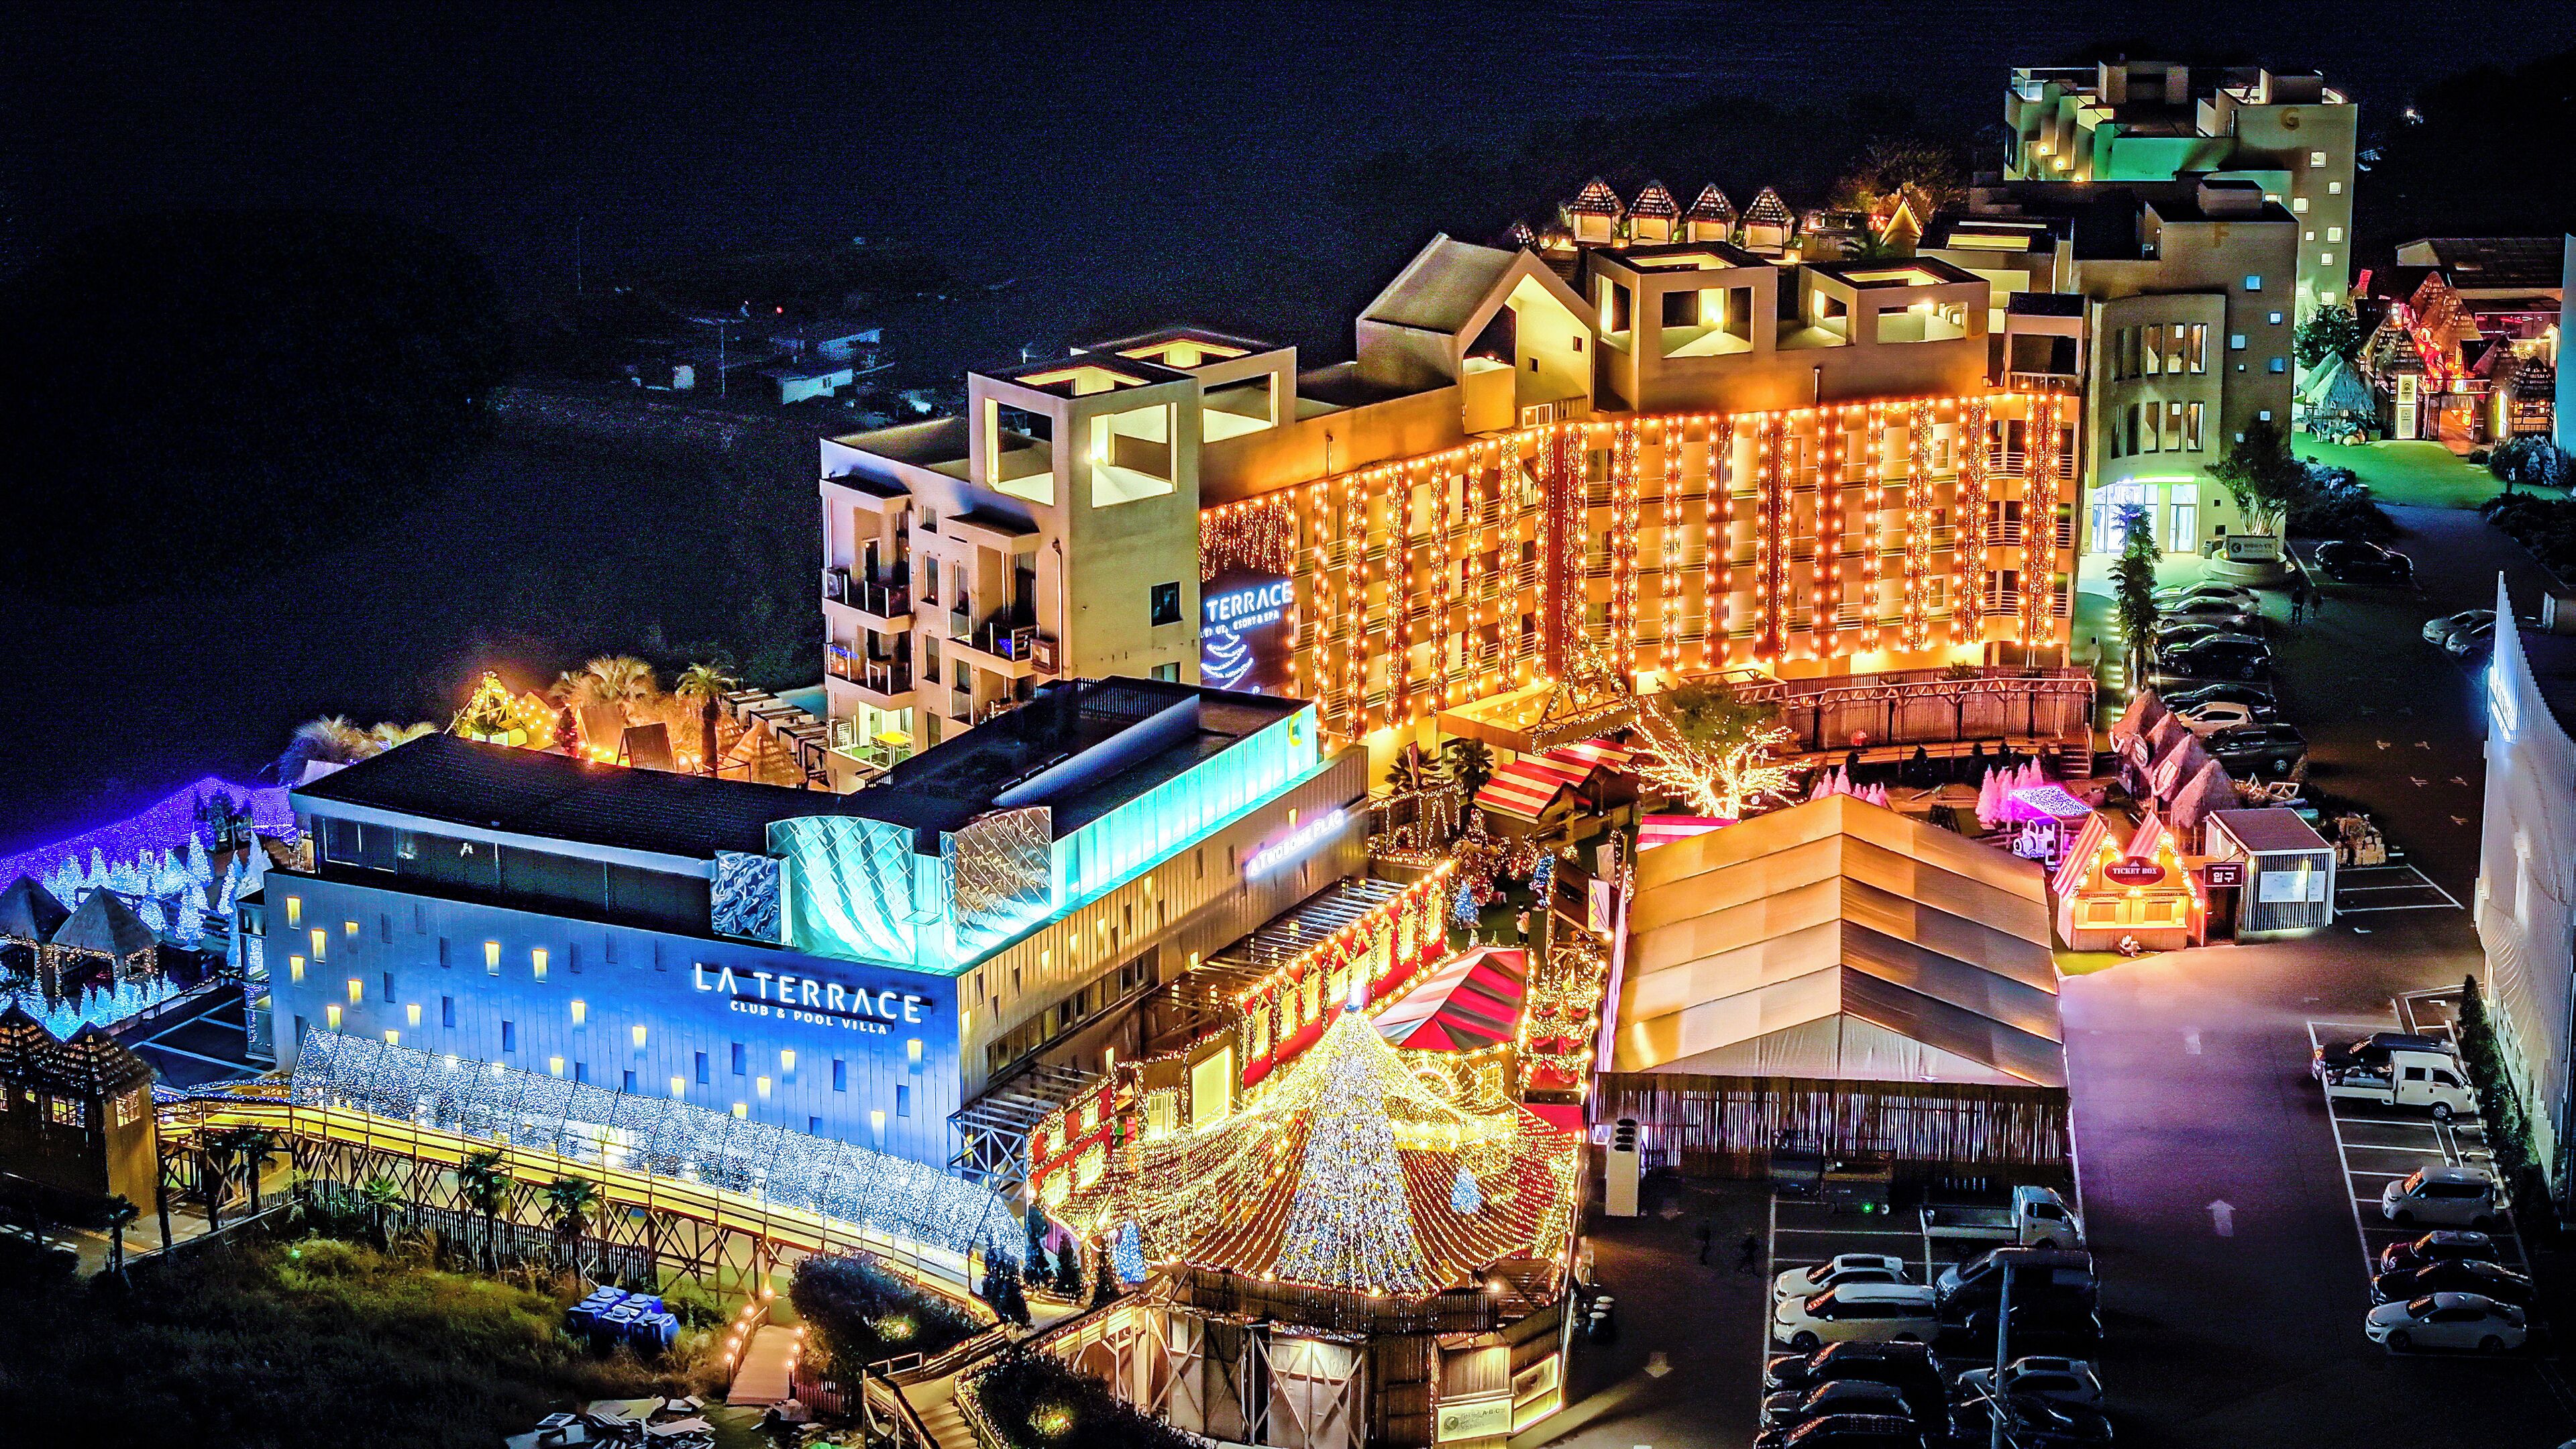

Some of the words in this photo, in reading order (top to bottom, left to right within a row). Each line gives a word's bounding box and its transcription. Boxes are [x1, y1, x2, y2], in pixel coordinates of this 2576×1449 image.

[2280, 107, 2300, 131] G
[2214, 222, 2231, 248] F
[1205, 580, 1294, 623] TERRACE
[2213, 871, 2235, 883] 입구
[695, 962, 739, 996] LA
[753, 971, 922, 1024] TERRACE
[730, 1000, 769, 1016] CLUB
[776, 1008, 786, 1019] &
[794, 1011, 834, 1027] POOL
[842, 1018, 888, 1036] VILLA
